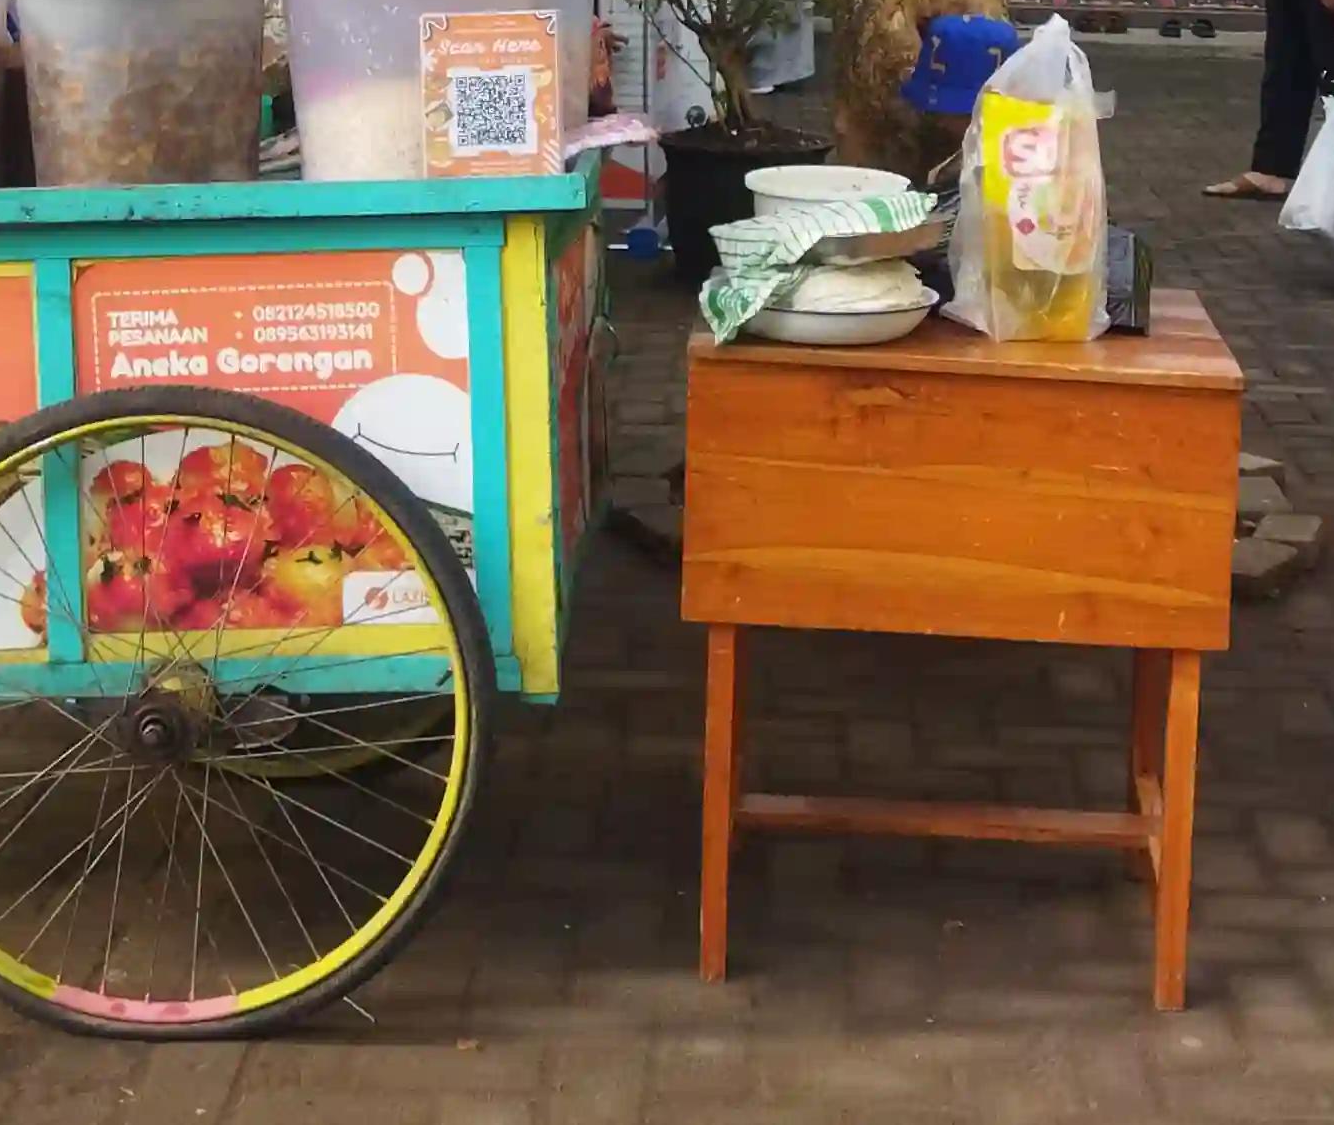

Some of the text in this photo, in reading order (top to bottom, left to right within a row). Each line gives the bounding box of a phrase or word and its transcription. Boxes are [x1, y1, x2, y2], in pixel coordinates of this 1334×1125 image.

[105, 308, 179, 328] TERIMA
[108, 326, 208, 347] PESANAAN
[111, 347, 373, 380] Aneka Gorengan
